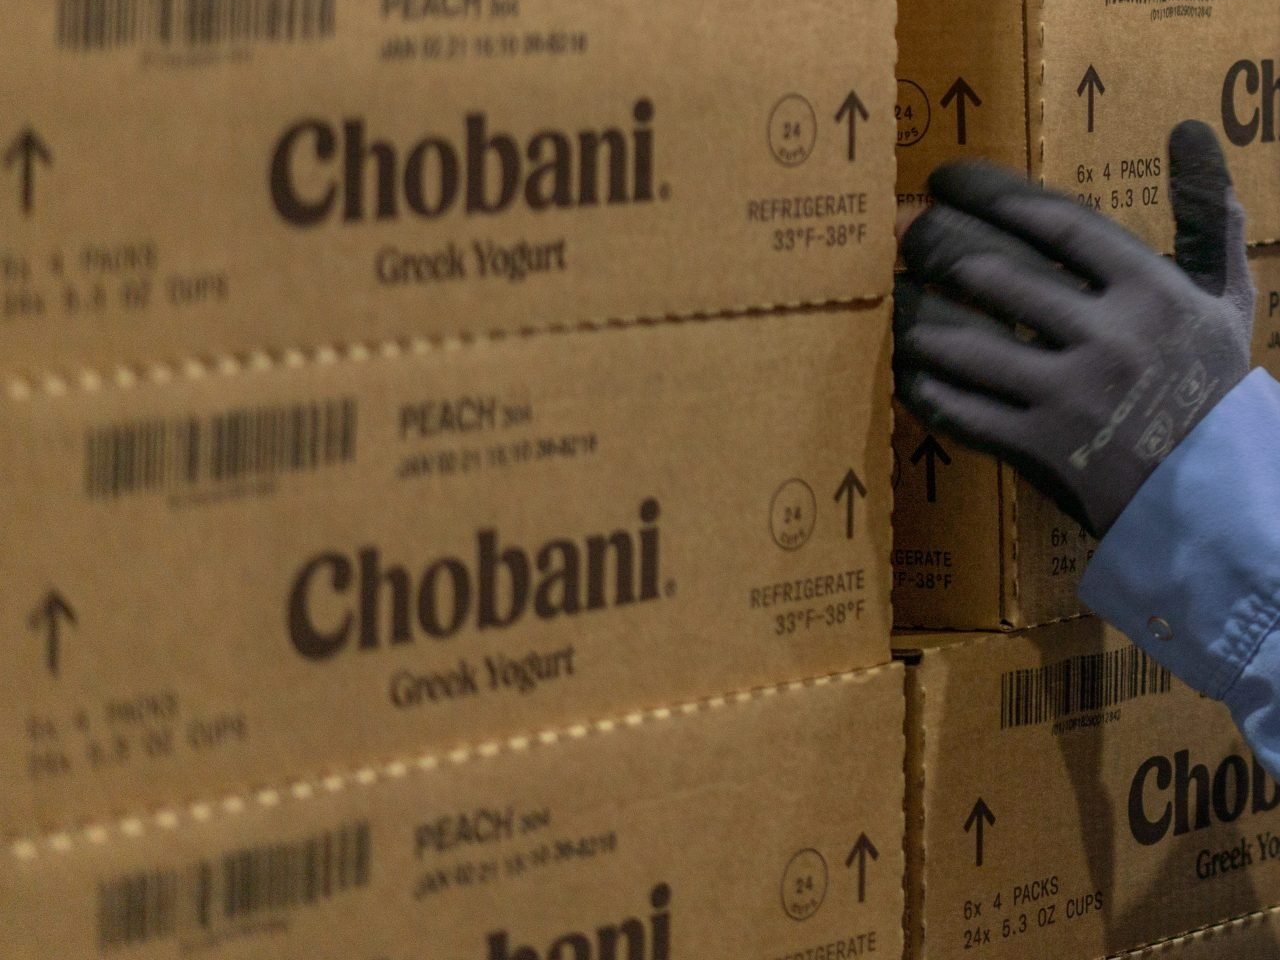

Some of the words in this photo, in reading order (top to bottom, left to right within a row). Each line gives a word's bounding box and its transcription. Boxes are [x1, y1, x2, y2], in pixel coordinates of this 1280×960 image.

[783, 122, 801, 141] 24
[1077, 164, 1093, 183] 6x
[1103, 163, 1111, 180] 4
[1121, 157, 1161, 179] PACKS
[749, 193, 867, 222] REFRIGERATE
[1111, 189, 1133, 209] 5.3
[1142, 186, 1158, 206] OZ
[376, 242, 466, 285] Greek
[472, 239, 566, 283] Yogurt
[398, 397, 496, 440] PEACH
[784, 506, 801, 524] 24
[892, 549, 952, 567] GERATE
[1052, 555, 1076, 576] 24x
[750, 570, 866, 609] REFRIGERATE
[390, 660, 478, 708] Greek
[484, 645, 575, 696] Yogurt
[413, 807, 514, 858] PEACH
[1196, 837, 1253, 880] Greek
[796, 876, 813, 894] 24
[963, 901, 982, 921] 6x
[993, 892, 1002, 910] 4
[1013, 876, 1059, 906] PACKS
[964, 927, 990, 950] 24x
[1002, 914, 1027, 938] 5.3
[1038, 905, 1056, 927] OZ
[1066, 891, 1104, 918] CUPS
